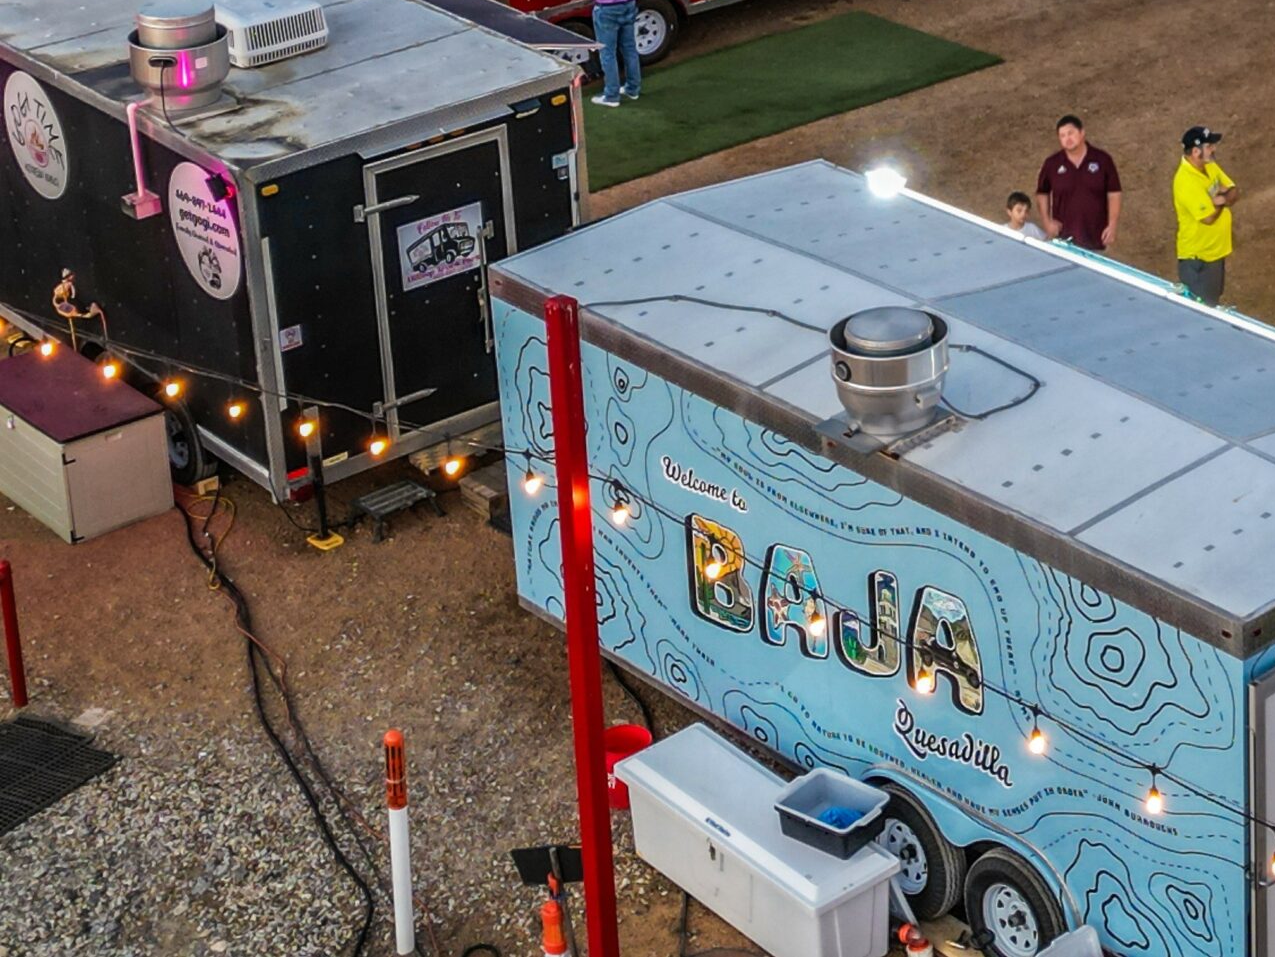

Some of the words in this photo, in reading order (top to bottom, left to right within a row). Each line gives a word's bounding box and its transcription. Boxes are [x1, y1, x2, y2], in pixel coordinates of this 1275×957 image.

[33, 98, 66, 171] TIME
[662, 456, 728, 502] Welcome
[731, 488, 748, 512] to
[734, 462, 753, 481] SOUL
[767, 486, 787, 503] FROM
[857, 525, 876, 536] SURE
[878, 528, 887, 536] OF
[916, 526, 932, 536] AND
[943, 532, 976, 559] INTEND
[979, 560, 990, 575] TO
[990, 579, 1004, 603] END
[1000, 607, 1008, 624] UP
[685, 513, 985, 715] BAJA
[691, 642, 716, 667] TWAIN
[800, 704, 810, 719] TO
[812, 719, 841, 741] NATURE
[843, 733, 853, 743] TO
[856, 737, 866, 749] BE
[946, 786, 963, 801] AND
[964, 796, 986, 814] HAVE
[988, 808, 1000, 817] MY
[1002, 801, 1029, 817] SENSES
[1029, 790, 1044, 805] PUT
[1044, 786, 1054, 796] IN
[1124, 808, 1178, 836] BURROUGHS
[893, 698, 1013, 787] Quesadilla
